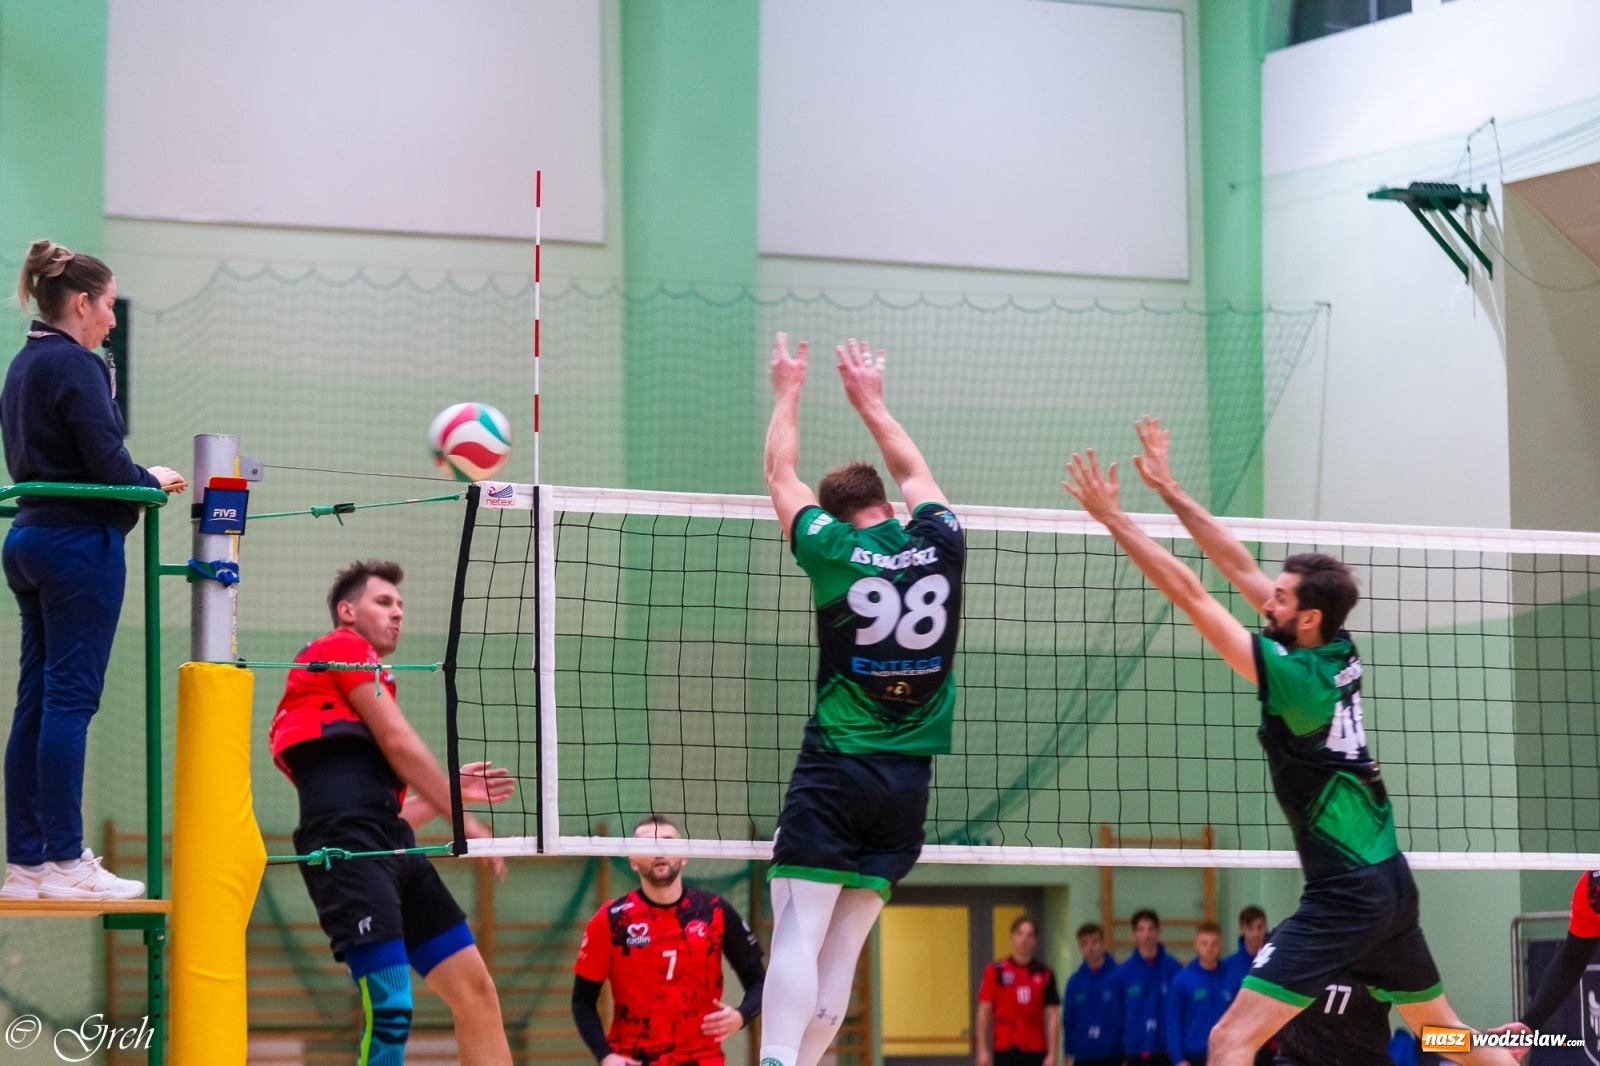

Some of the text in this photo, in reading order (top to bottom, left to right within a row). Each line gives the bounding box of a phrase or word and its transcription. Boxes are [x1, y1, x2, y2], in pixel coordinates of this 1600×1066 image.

[486, 498, 513, 506] netex
[213, 508, 237, 518] FIVB
[847, 574, 950, 650] 98
[662, 949, 677, 981] 7
